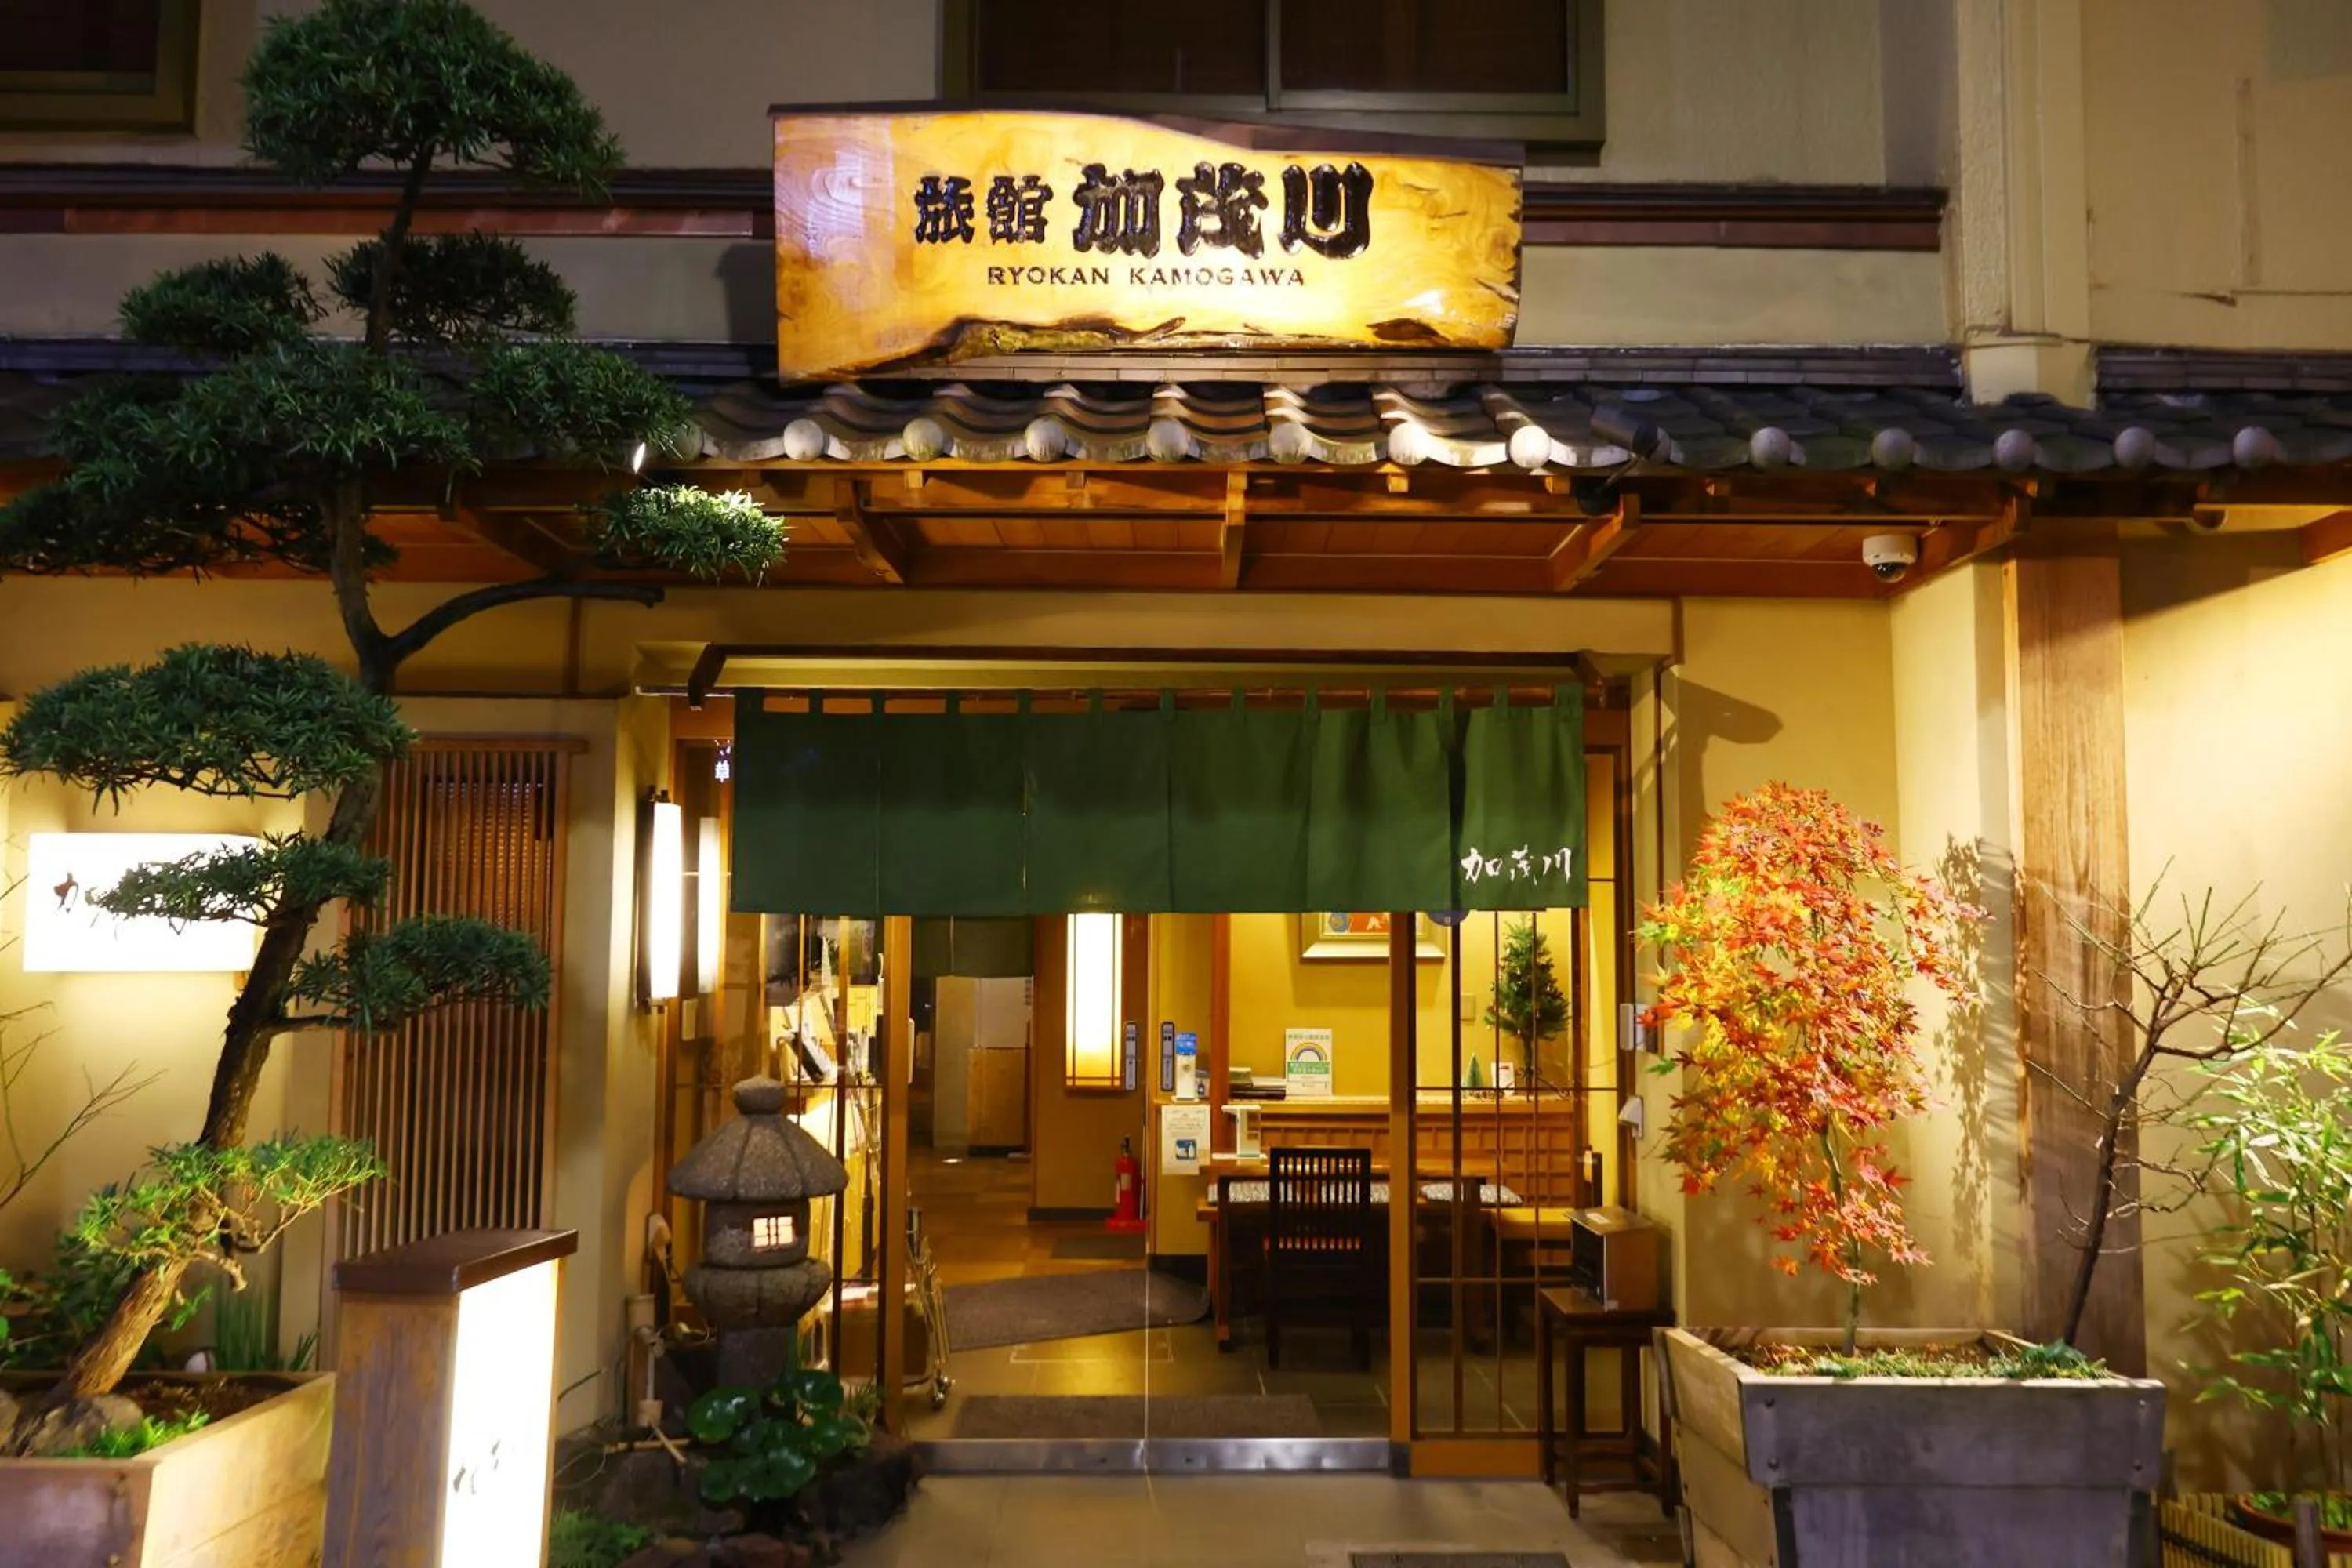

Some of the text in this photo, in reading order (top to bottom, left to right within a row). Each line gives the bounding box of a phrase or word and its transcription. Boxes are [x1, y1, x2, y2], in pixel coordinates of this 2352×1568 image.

[913, 160, 1375, 260] 旅館 加茂川
[987, 266, 1305, 286] RYOKAN KAMOGAWA
[1460, 843, 1572, 886] 加茂川
